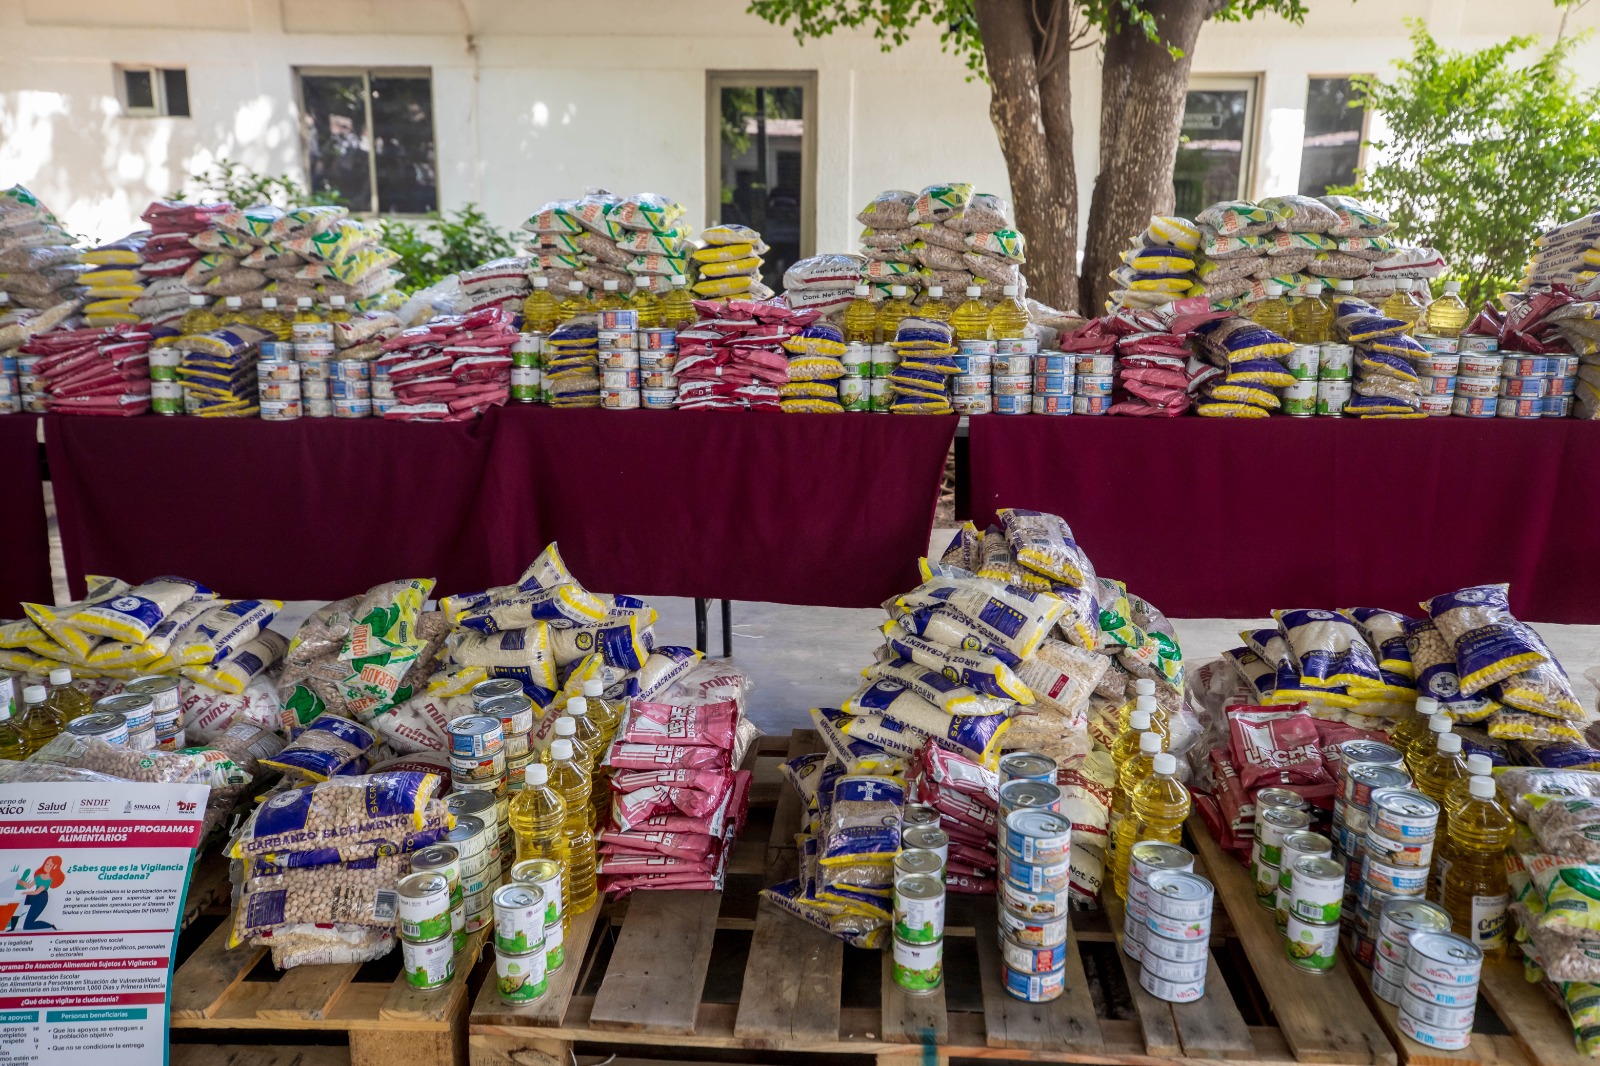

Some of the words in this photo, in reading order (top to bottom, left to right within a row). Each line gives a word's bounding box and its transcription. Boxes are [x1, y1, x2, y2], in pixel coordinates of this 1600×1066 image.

[245, 608, 267, 626] ARROZ
[953, 655, 981, 669] ARROZ
[654, 661, 689, 691] SACRAMENTO
[635, 687, 655, 702] RROZ
[914, 684, 935, 700] ARROZ
[180, 694, 203, 714] nsa
[424, 702, 448, 736] mín
[394, 723, 445, 751] mínsa
[899, 721, 964, 754] SACRAMENTO
[1245, 743, 1321, 765] LECHE
[399, 762, 449, 777] urizada
[38, 802, 67, 811] Salud
[80, 799, 111, 807] SNDIF
[179, 802, 197, 811] DIF
[50, 825, 105, 834] CIUDADANA
[134, 825, 194, 834] PROGRAMAS
[247, 831, 317, 852] GARBANZO
[323, 817, 408, 839] SACRAMENTO
[58, 833, 128, 843] ALIMENTARIOS
[67, 864, 98, 873] ¿Sabes
[100, 866, 117, 874] que
[130, 864, 138, 872] la
[140, 863, 184, 873] Vigilancia
[98, 872, 151, 881] Ciudadana?
[1069, 865, 1086, 880] Net
[1088, 876, 1102, 888] 50
[769, 892, 801, 915] LENTEJA
[805, 911, 831, 930] SACRA
[137, 943, 166, 951] personales
[99, 960, 121, 968] Sujetos
[128, 959, 158, 967] Vigilancia
[21, 973, 59, 981] Alimentación
[119, 976, 161, 984] Vulnerabilidad
[55, 997, 75, 1005] vigilar
[82, 996, 119, 1004] ciudadanía?
[7, 1014, 33, 1022] apoyos:
[61, 1012, 88, 1020] Personas
[89, 1011, 128, 1019] beneficiarias
[59, 1032, 89, 1040] población
[122, 1042, 145, 1051] entrega
